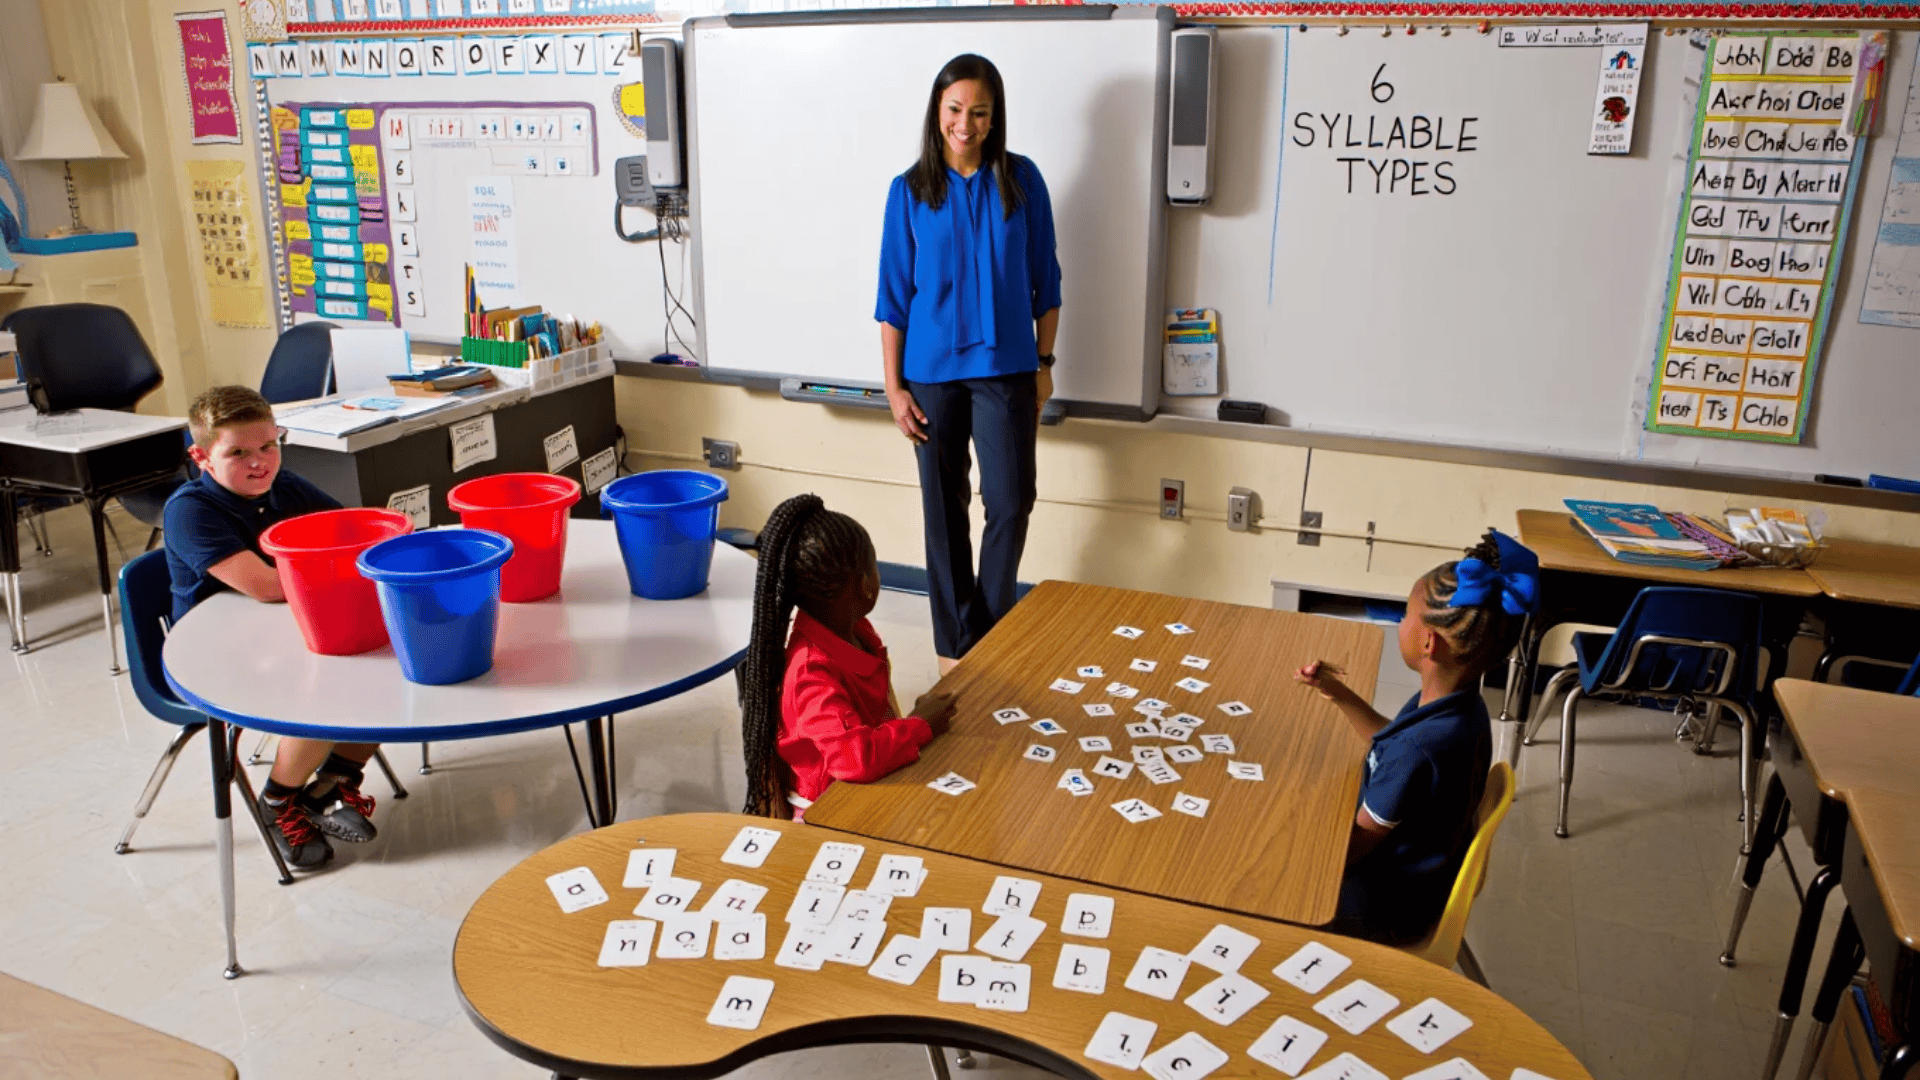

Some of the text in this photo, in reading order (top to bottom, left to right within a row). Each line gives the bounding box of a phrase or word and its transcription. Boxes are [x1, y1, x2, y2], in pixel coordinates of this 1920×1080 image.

[535, 43, 550, 64] X
[1371, 63, 1395, 103] 6
[1292, 111, 1478, 152] SYLLABLE
[1336, 157, 1457, 196] TYPES
[956, 968, 975, 987] b
[726, 996, 753, 1011] m
